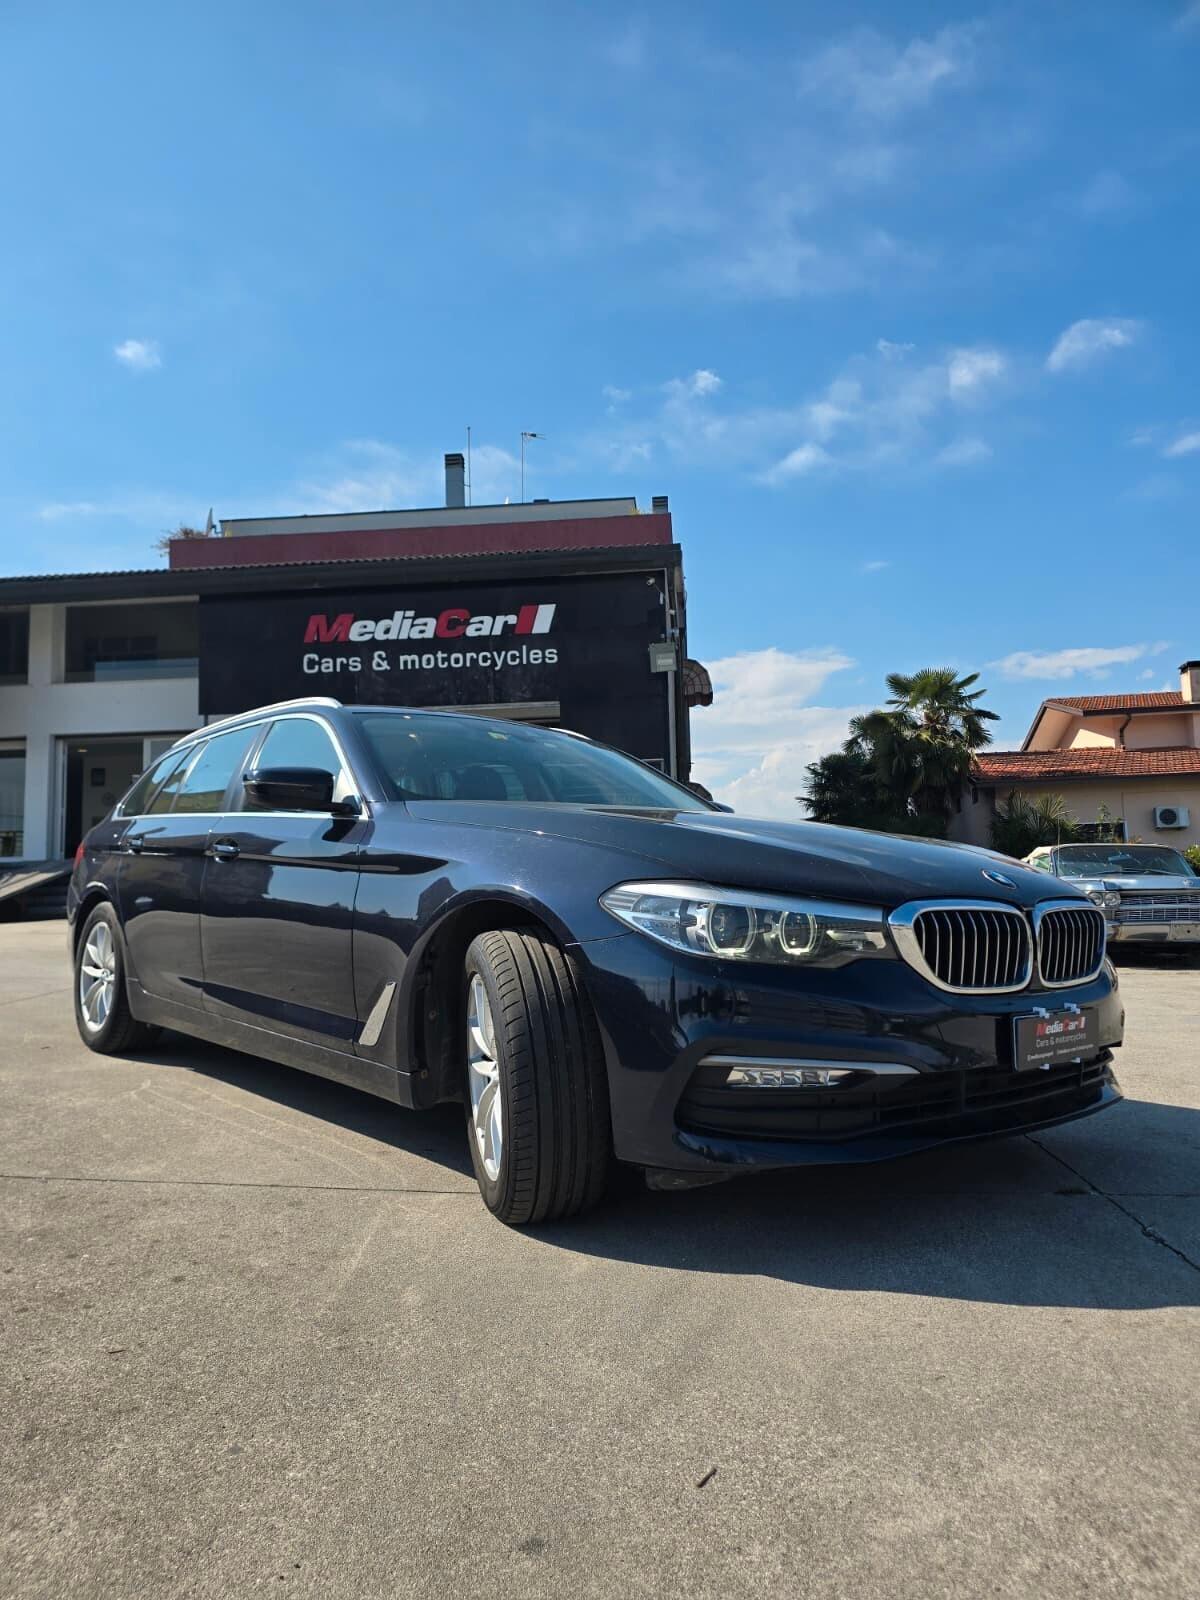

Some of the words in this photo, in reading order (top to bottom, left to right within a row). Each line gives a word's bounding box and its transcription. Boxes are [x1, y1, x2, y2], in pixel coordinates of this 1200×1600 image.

[302, 653, 362, 673] Cars
[372, 651, 391, 671] &
[400, 645, 558, 670] motorcycles
